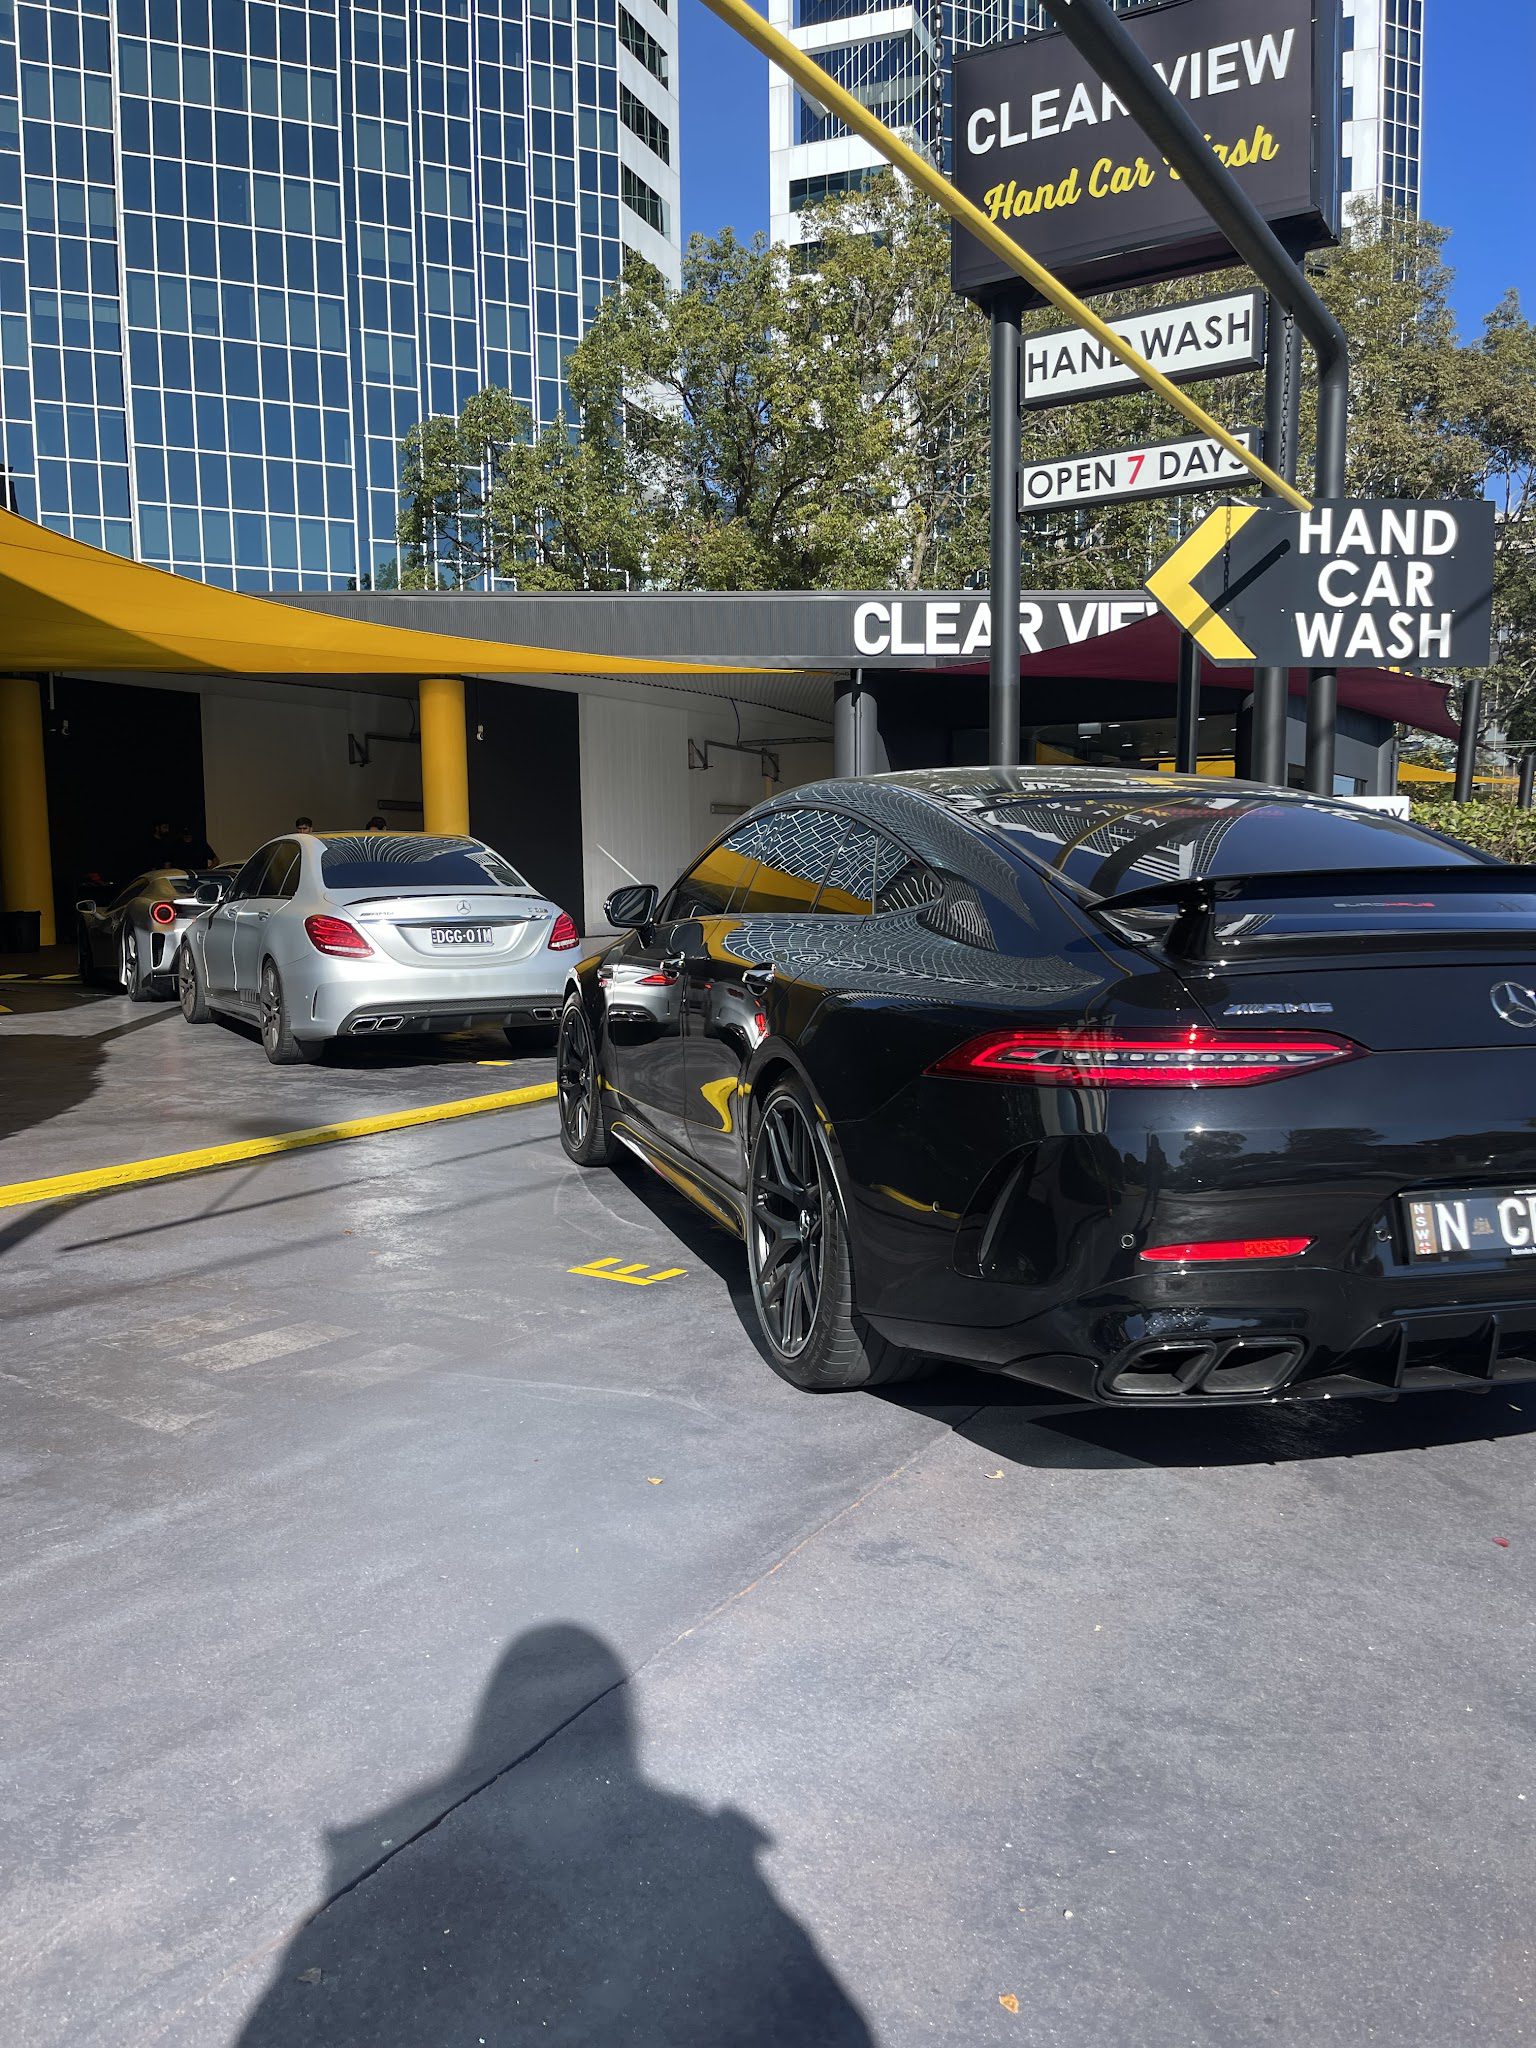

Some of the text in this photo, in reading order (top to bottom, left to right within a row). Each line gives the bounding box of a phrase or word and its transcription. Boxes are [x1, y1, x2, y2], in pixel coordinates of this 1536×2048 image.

[1153, 28, 1294, 99] VIEW
[982, 168, 1081, 222] Hand
[1088, 157, 1155, 198] Car
[1141, 310, 1250, 360] WASH
[1028, 460, 1115, 498] OPEN
[1127, 455, 1145, 485] 7
[1299, 508, 1458, 555] HAND
[1318, 560, 1434, 607] CAR
[854, 602, 1043, 656] CLEAR
[1295, 612, 1453, 659] WASH
[1260, 1003, 1333, 1013] AMG
[1413, 1204, 1431, 1240] NSW
